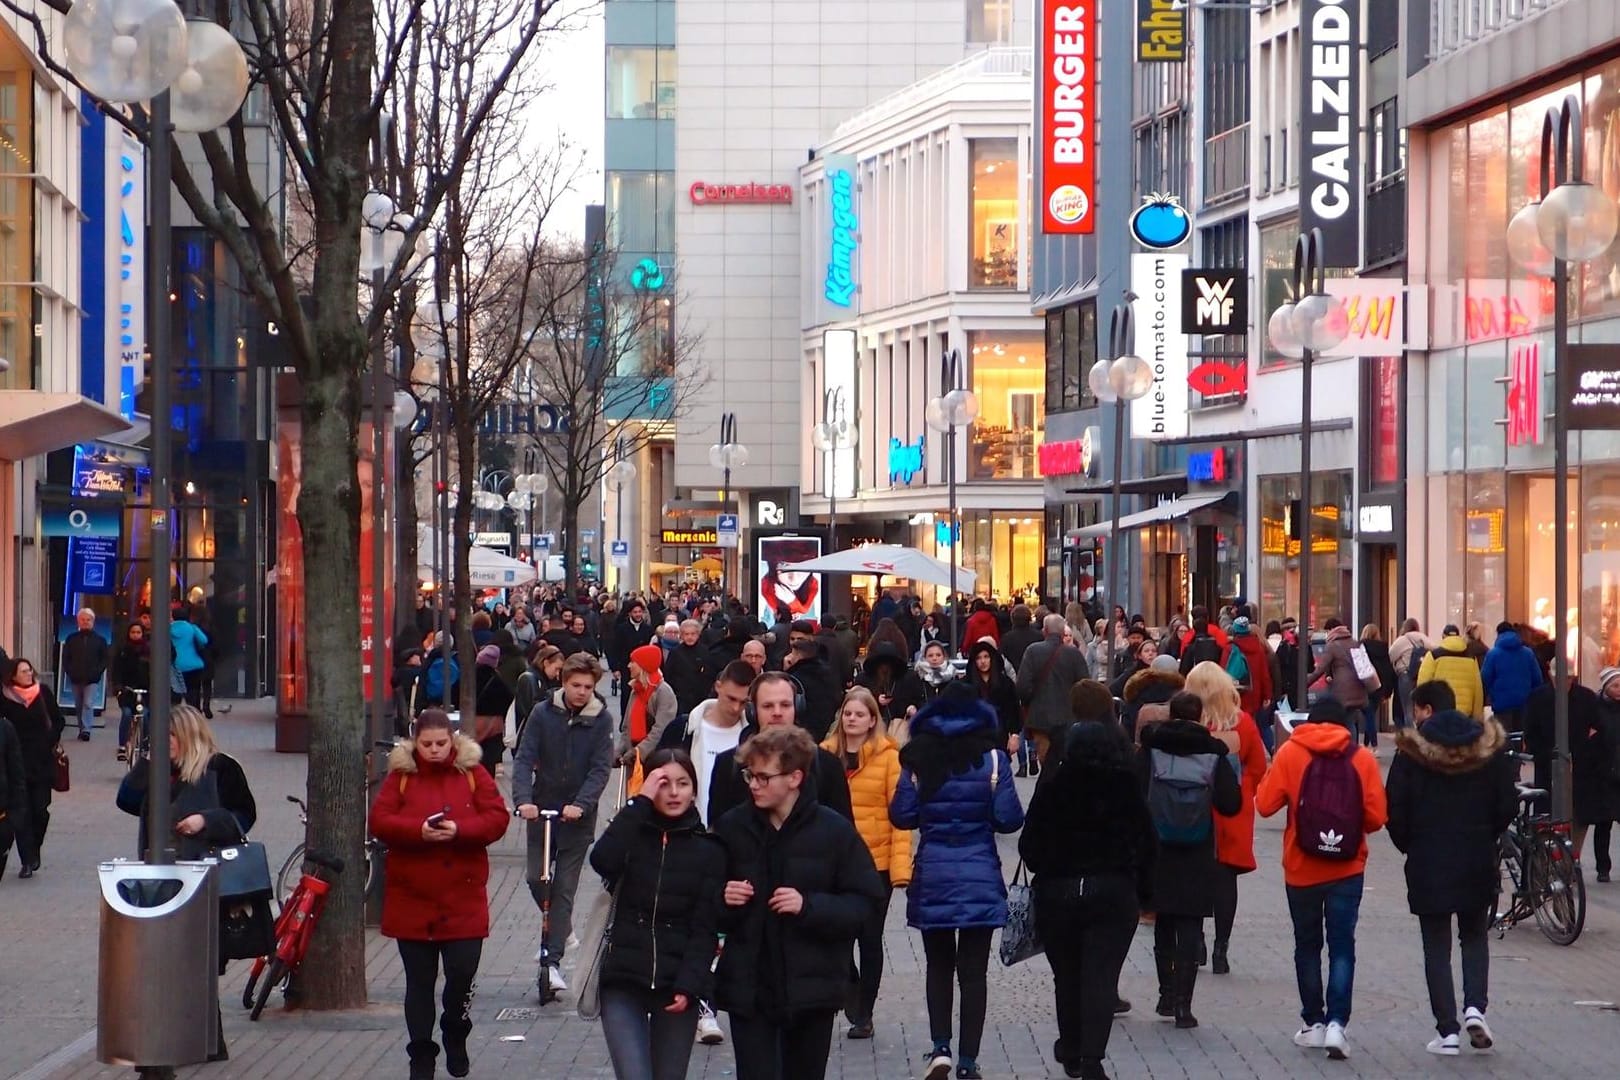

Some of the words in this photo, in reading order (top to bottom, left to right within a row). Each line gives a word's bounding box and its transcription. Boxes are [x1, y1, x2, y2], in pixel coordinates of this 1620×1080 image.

[1053, 5, 1085, 163] BURGER
[1310, 0, 1350, 219] CALZED
[825, 169, 857, 307] Kämpgen
[1056, 200, 1083, 214] KING
[1151, 258, 1165, 433] blue-tomato.com
[69, 509, 91, 532] O2
[662, 530, 717, 543] Merzenic
